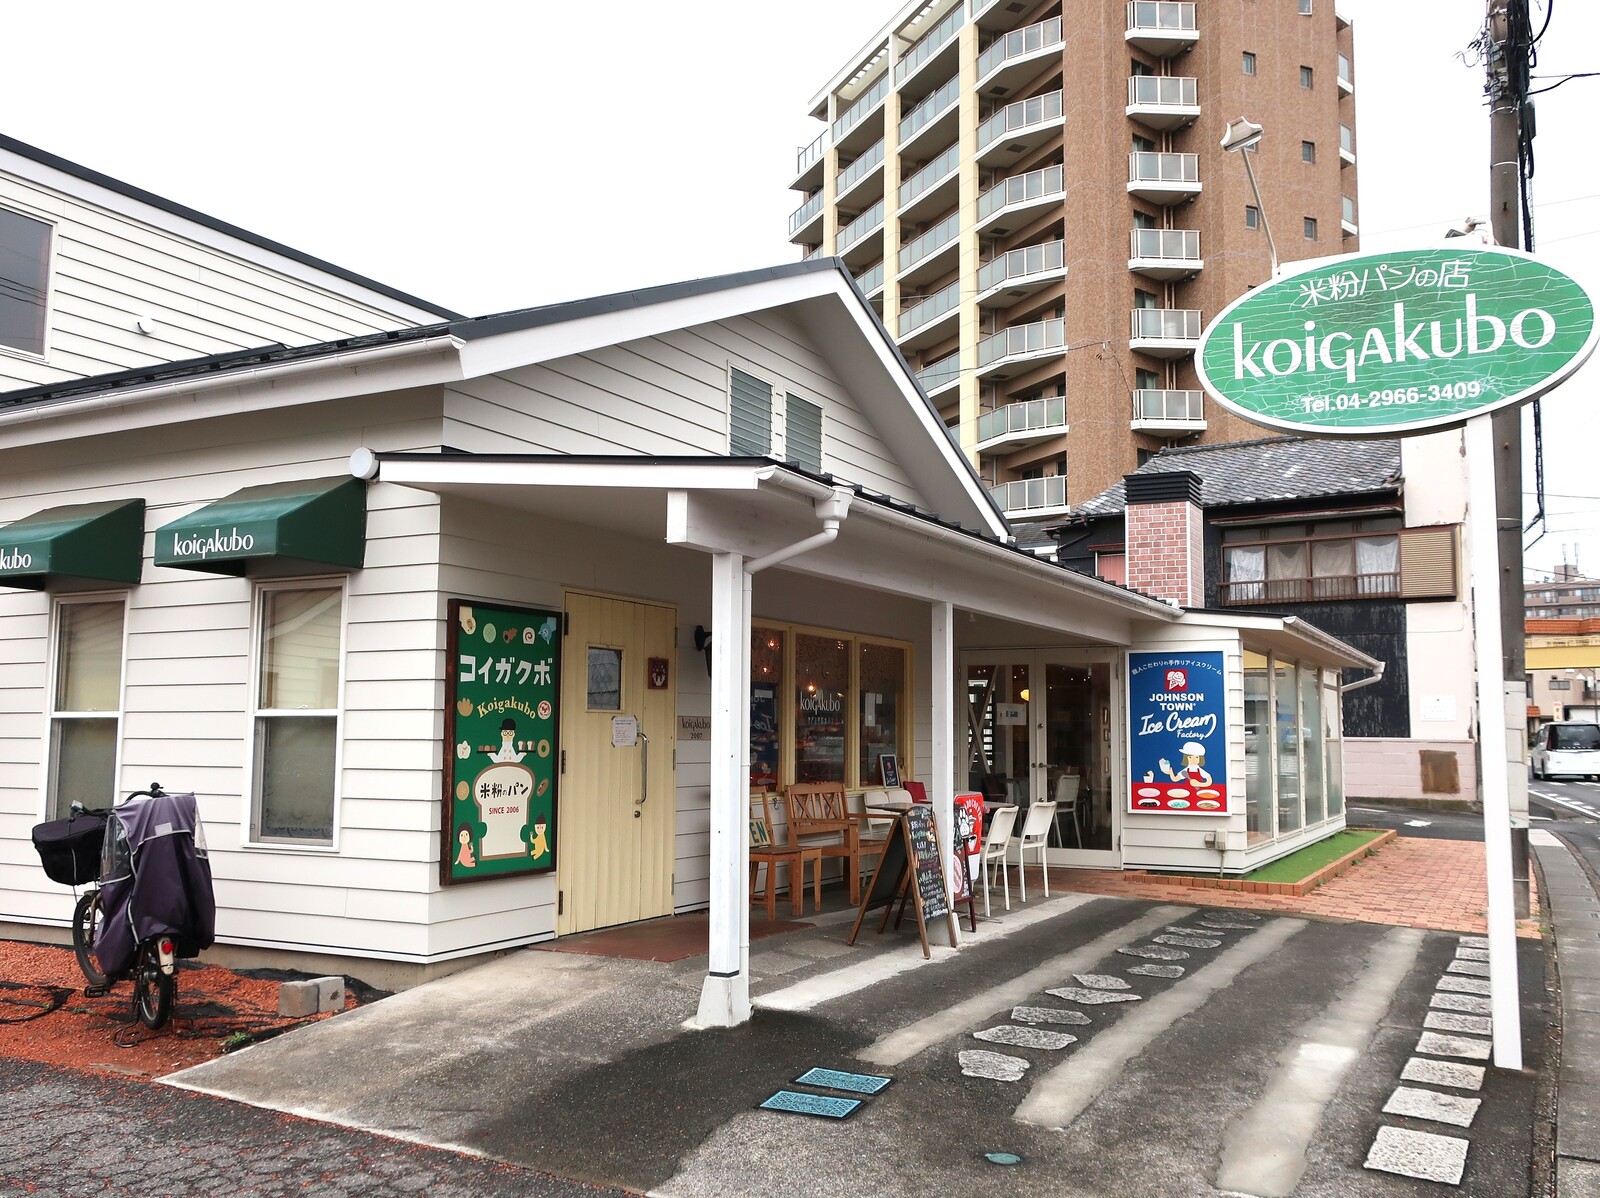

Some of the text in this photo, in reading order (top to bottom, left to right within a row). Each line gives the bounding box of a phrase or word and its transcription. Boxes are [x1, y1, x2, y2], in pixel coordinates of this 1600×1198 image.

[1300, 259, 1472, 308] 米粉パンの店
[460, 654, 553, 686] コイガクボ
[477, 696, 536, 719] Koigakubo
[1149, 693, 1204, 702] JOHNSON
[1138, 711, 1217, 738] Ice Cream
[1177, 729, 1206, 740] Factory
[480, 782, 529, 799] 米粉のパン
[488, 806, 520, 815] SINCE 2006
